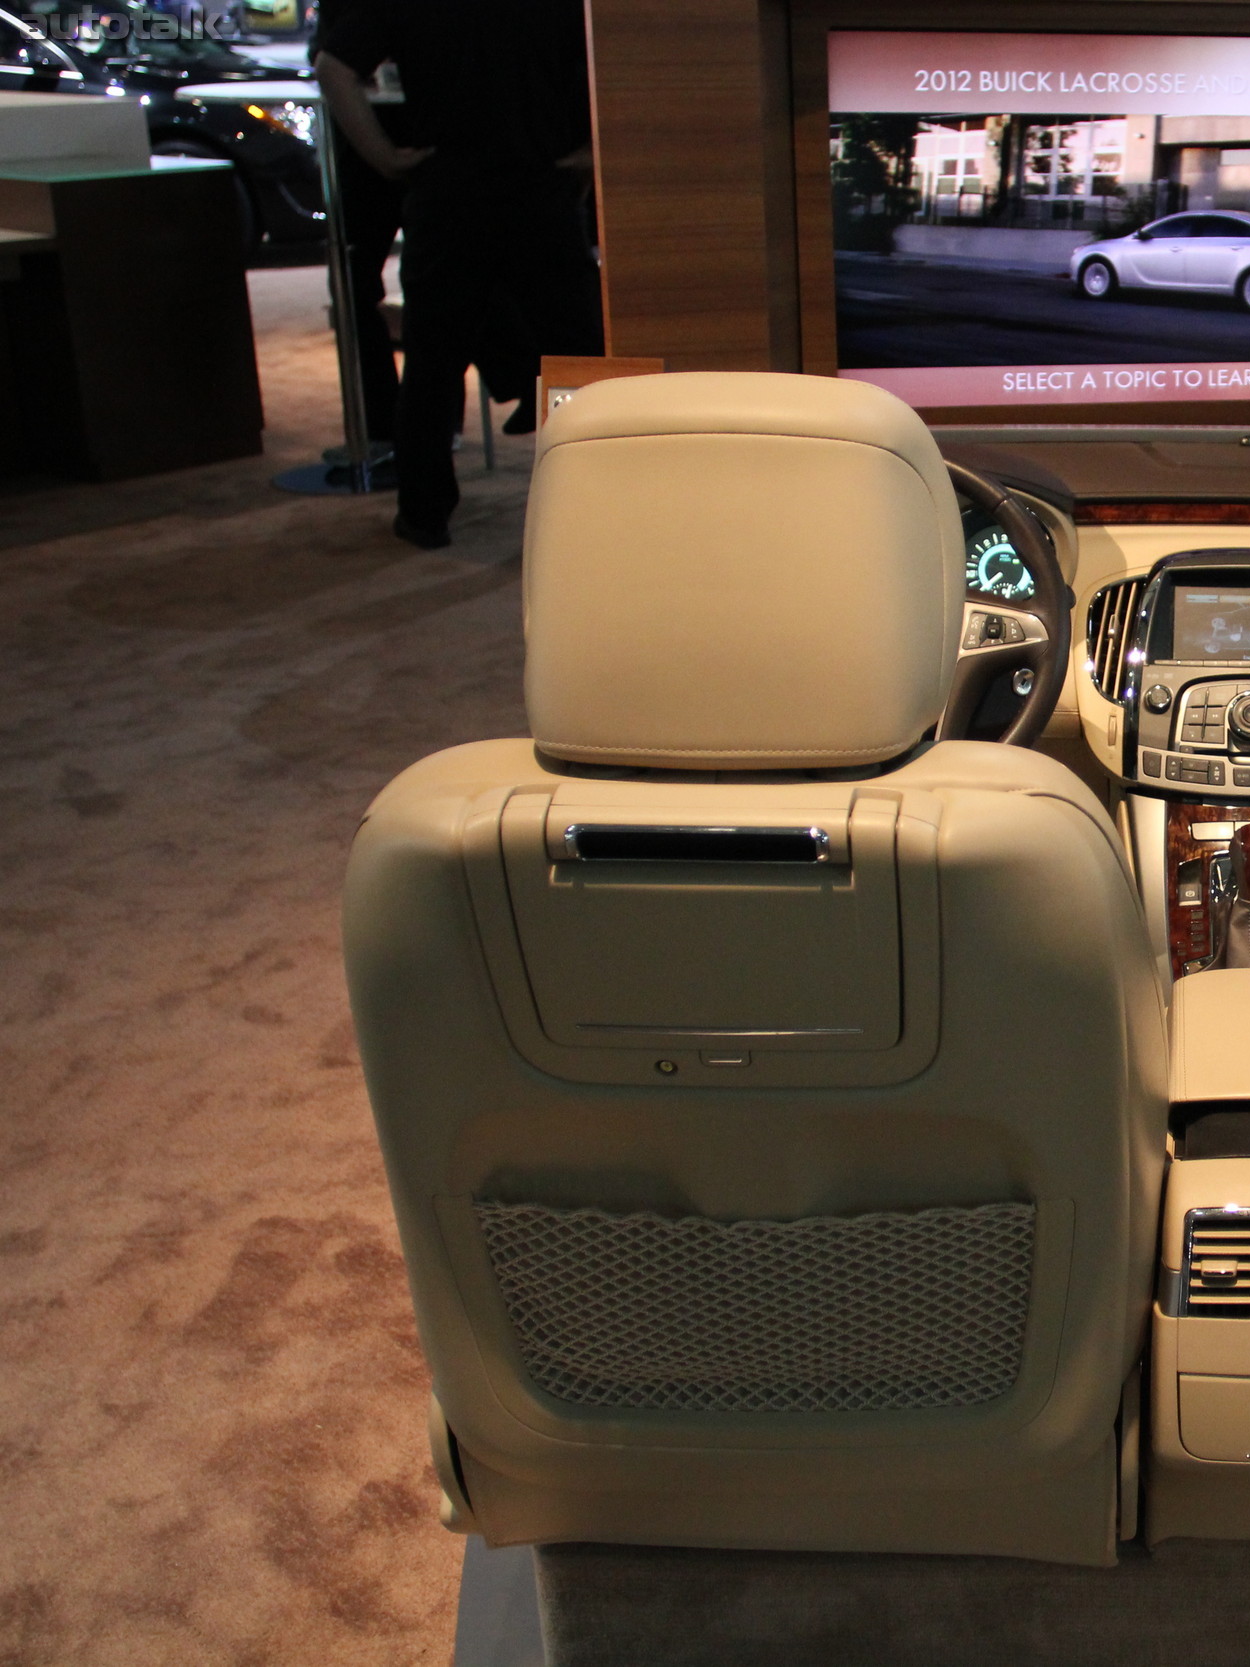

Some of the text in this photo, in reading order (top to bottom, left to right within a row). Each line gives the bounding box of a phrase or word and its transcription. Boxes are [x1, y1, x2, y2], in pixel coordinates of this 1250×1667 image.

[914, 69, 972, 92] 2012
[979, 70, 1053, 93] BUICK
[1059, 71, 1187, 94] LACROSSE
[1192, 74, 1248, 95] AND
[1003, 371, 1075, 391] SELECT
[1080, 371, 1097, 389] A
[1103, 369, 1168, 389] TOPIC
[1172, 369, 1203, 388] TO
